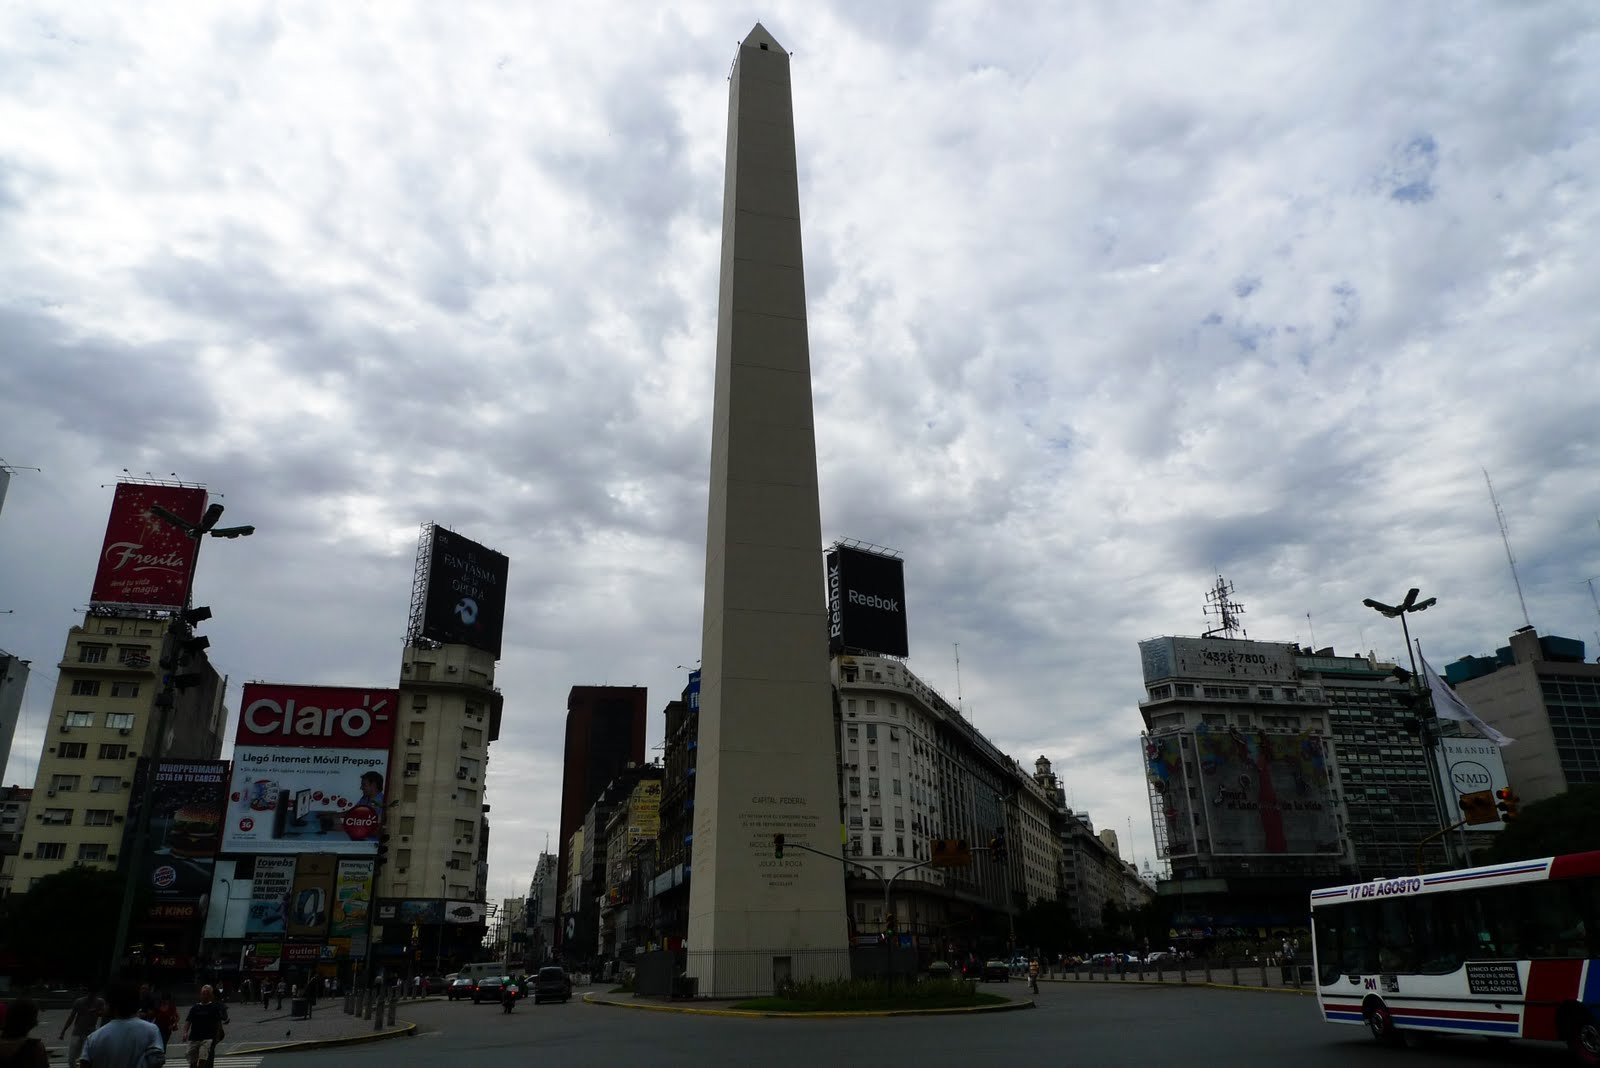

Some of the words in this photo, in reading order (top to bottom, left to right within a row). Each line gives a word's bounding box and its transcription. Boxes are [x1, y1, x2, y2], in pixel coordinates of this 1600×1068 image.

[105, 541, 184, 571] Fresita
[132, 585, 159, 595] magia
[829, 564, 841, 638] Reebok
[848, 589, 899, 613] Reebok
[244, 698, 372, 737] Claro
[243, 754, 269, 765] Llegó
[272, 754, 310, 764] Internet
[313, 754, 340, 764] Móvil
[342, 756, 384, 767] Prepago.
[185, 774, 193, 782] TU
[1454, 773, 1488, 784] NMD
[346, 817, 372, 826] Claro
[258, 858, 294, 867] towebs
[1350, 886, 1360, 899] 17
[1362, 884, 1375, 897] DE
[1376, 878, 1421, 896] AGOSTO
[1364, 978, 1377, 990] 241
